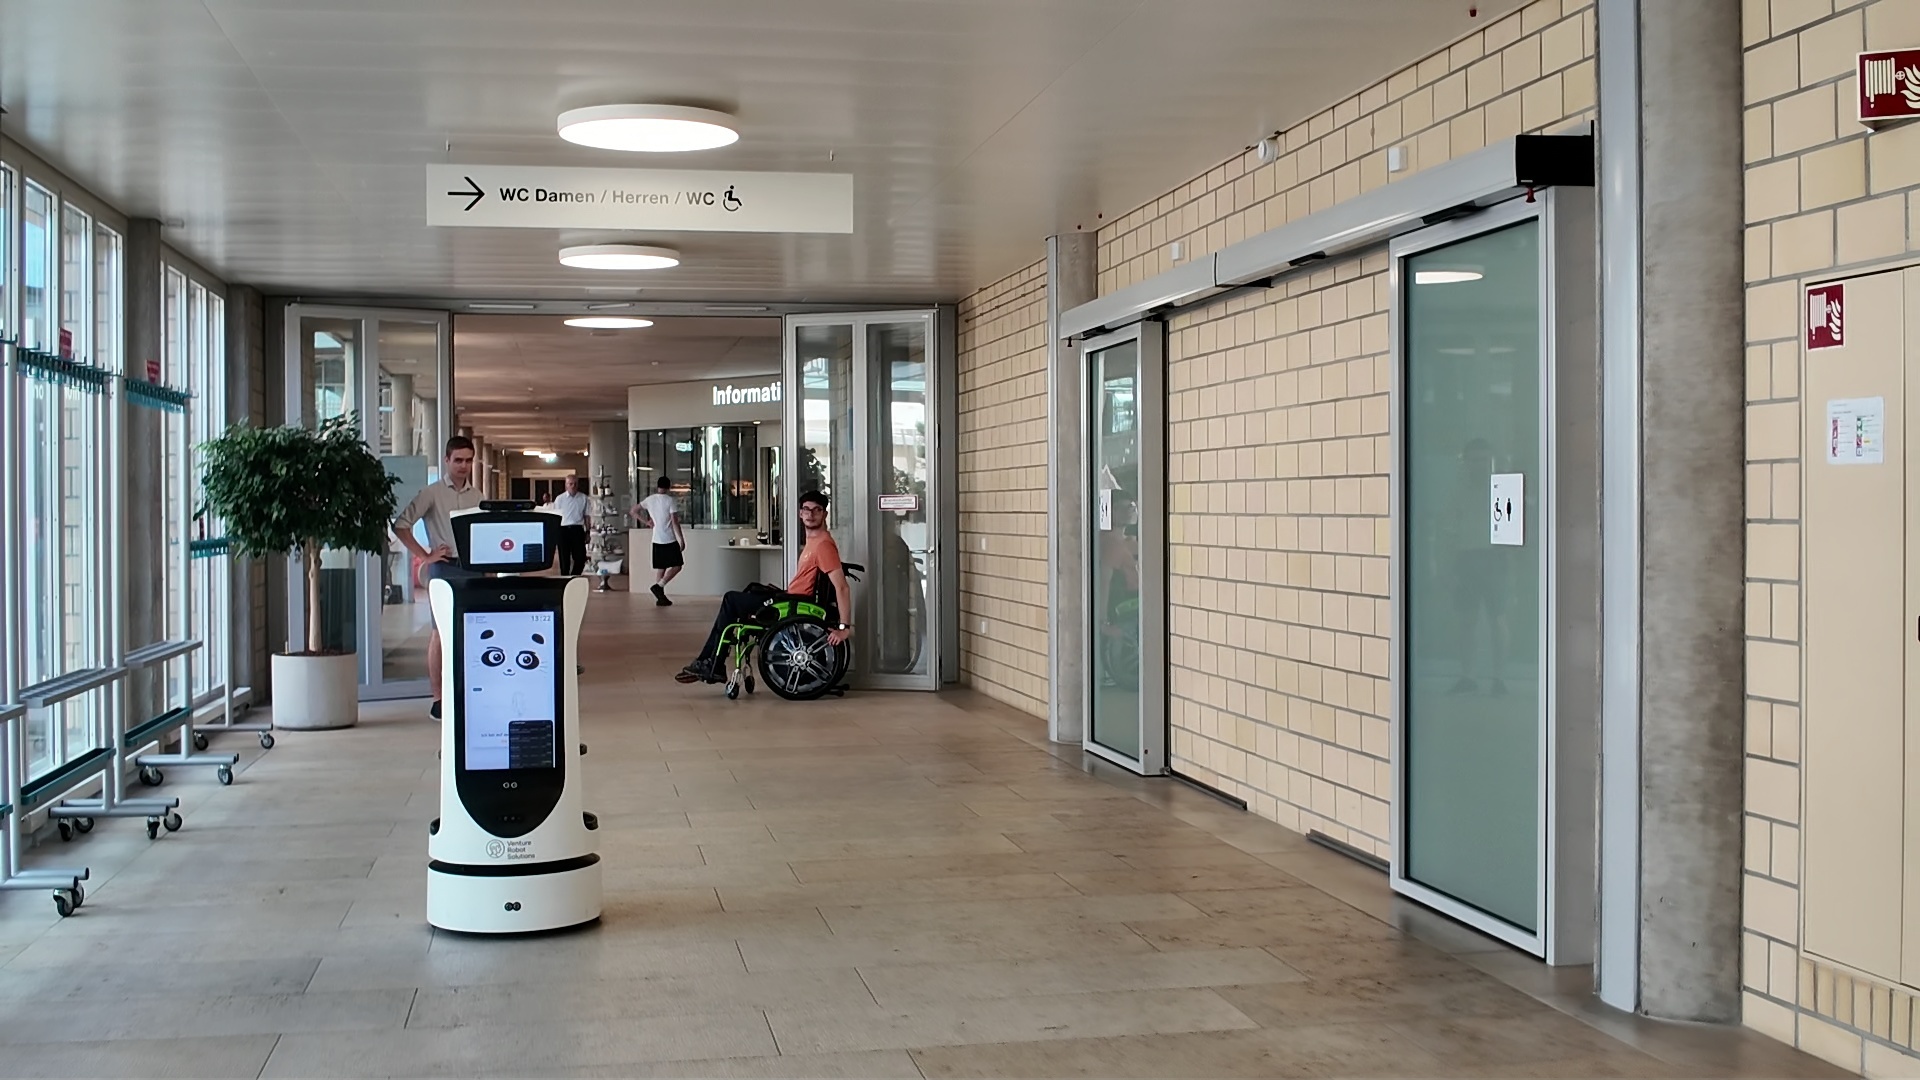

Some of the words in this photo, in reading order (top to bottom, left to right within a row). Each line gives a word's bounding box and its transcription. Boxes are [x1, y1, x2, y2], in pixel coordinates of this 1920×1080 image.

[499, 188, 529, 202] WC
[535, 188, 595, 203] Damen
[600, 189, 607, 204] /
[612, 190, 669, 204] Herren
[674, 191, 682, 204] /
[686, 191, 715, 206] WC
[712, 381, 782, 405] Informati
